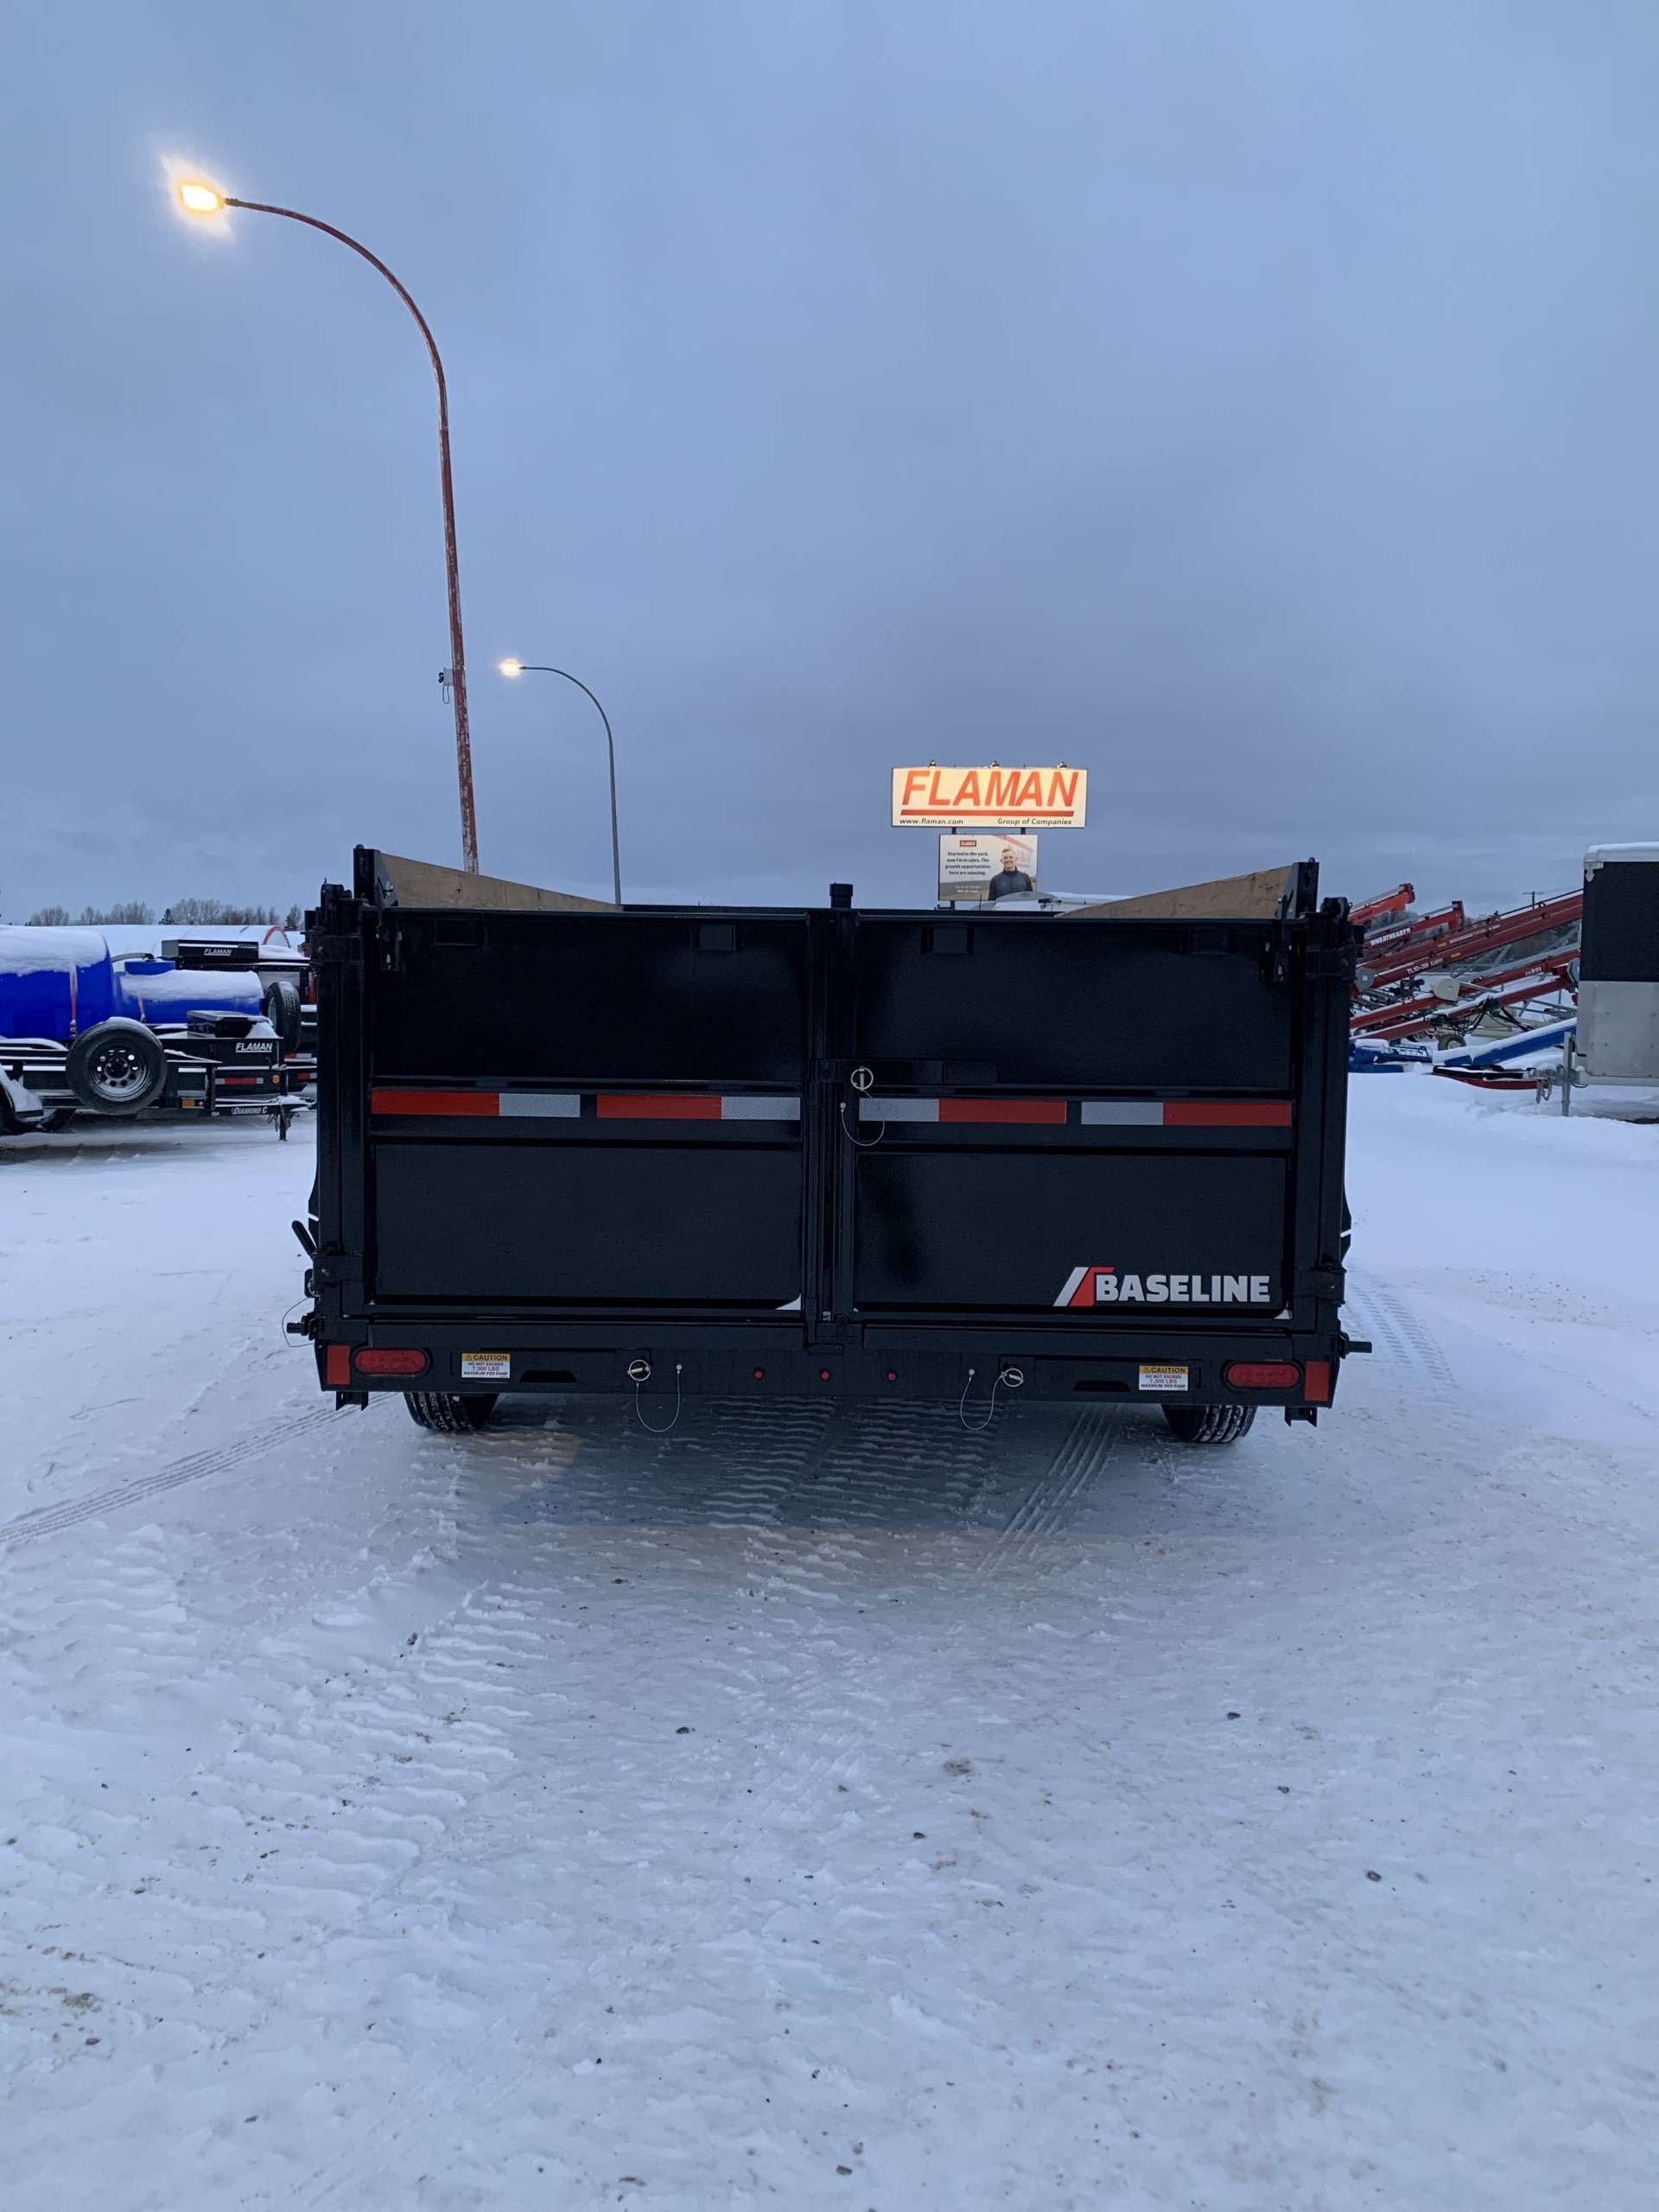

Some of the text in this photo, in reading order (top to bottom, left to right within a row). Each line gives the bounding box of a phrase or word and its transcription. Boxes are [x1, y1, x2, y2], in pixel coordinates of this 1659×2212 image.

[902, 770, 1079, 807] FLAMAN
[997, 817, 1020, 826] Group
[235, 1042, 273, 1053] FLAMAN
[1096, 1274, 1270, 1302] BASELINE
